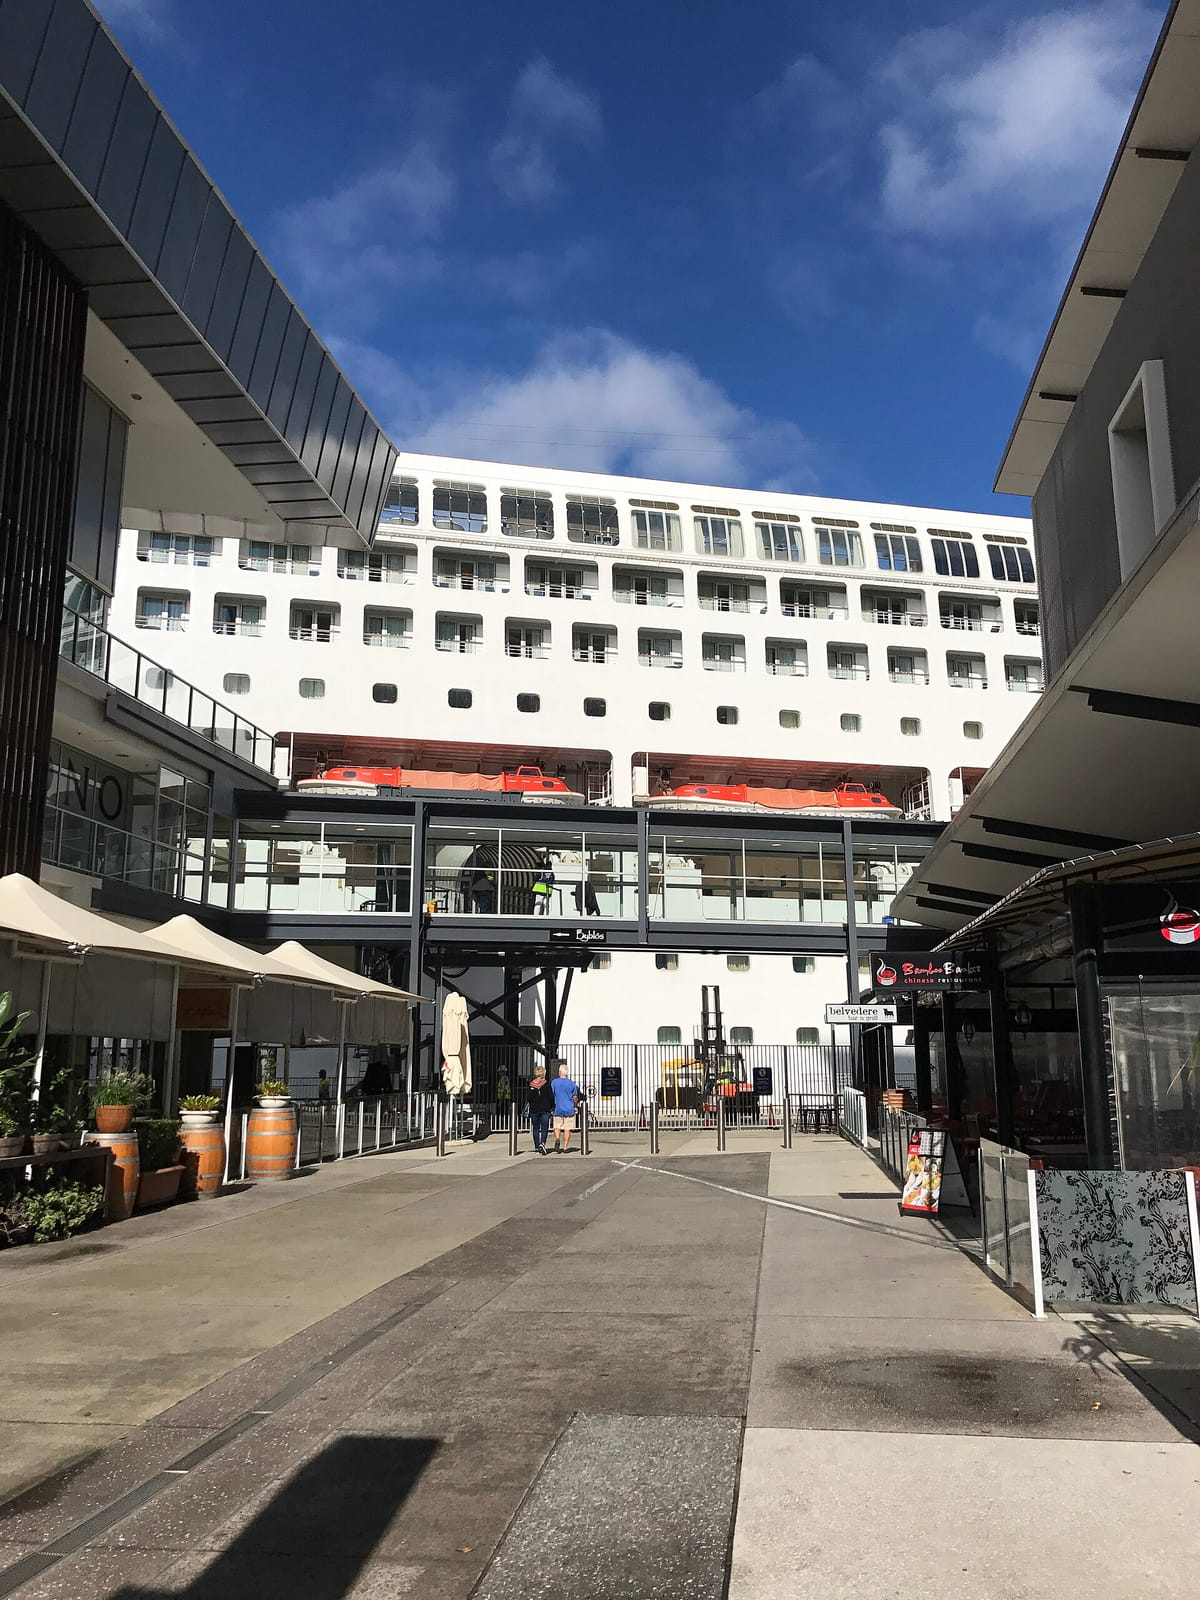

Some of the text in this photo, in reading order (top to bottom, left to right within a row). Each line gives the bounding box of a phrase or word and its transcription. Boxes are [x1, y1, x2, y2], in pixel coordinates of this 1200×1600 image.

[902, 962, 981, 976] Bamboo Basket
[830, 1006, 878, 1015] belvedere
